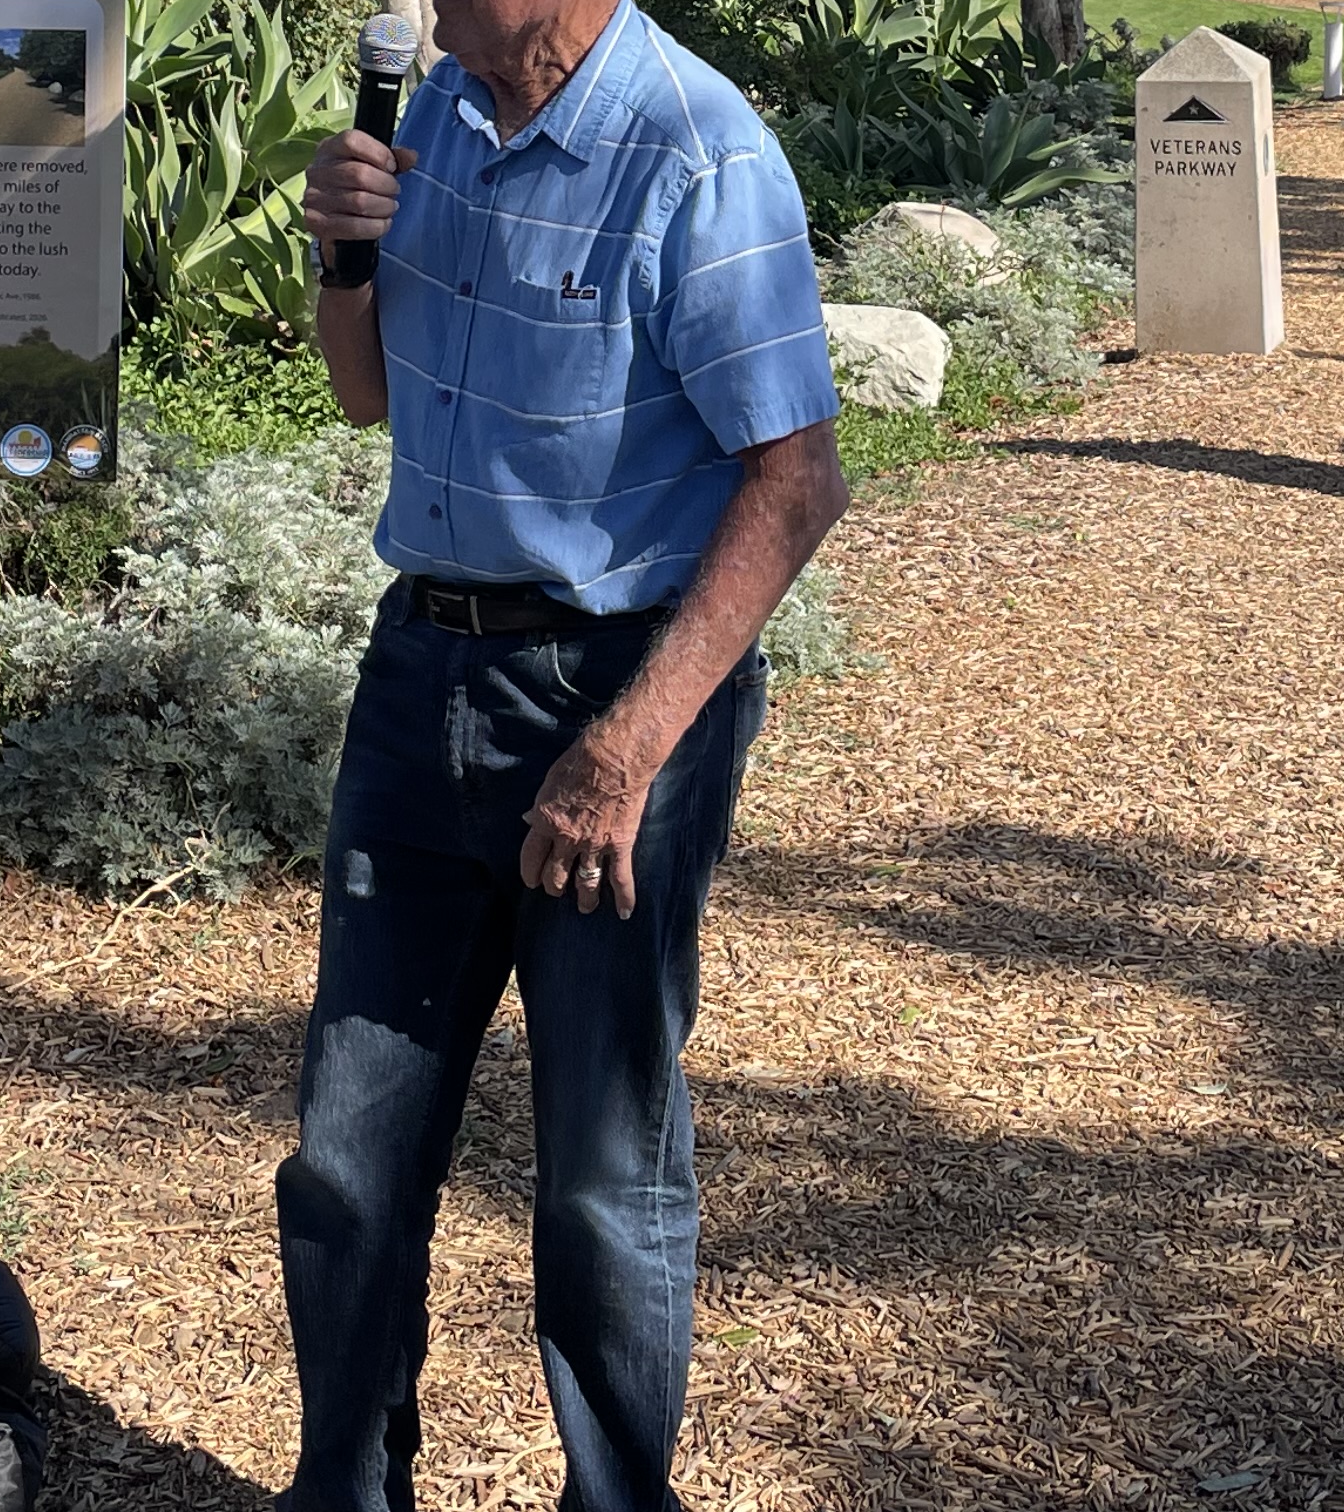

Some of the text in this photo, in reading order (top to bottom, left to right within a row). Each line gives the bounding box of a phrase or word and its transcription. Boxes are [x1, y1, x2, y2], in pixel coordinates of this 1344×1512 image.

[1150, 138, 1241, 155] VETERANS
[21, 158, 87, 175] removed,
[1154, 160, 1236, 176] PARKWAY
[3, 178, 41, 192] miles
[44, 179, 59, 193] of
[18, 200, 34, 213] to
[37, 199, 60, 213] the
[28, 219, 51, 234] the
[11, 240, 35, 254] the
[39, 240, 68, 255] lush
